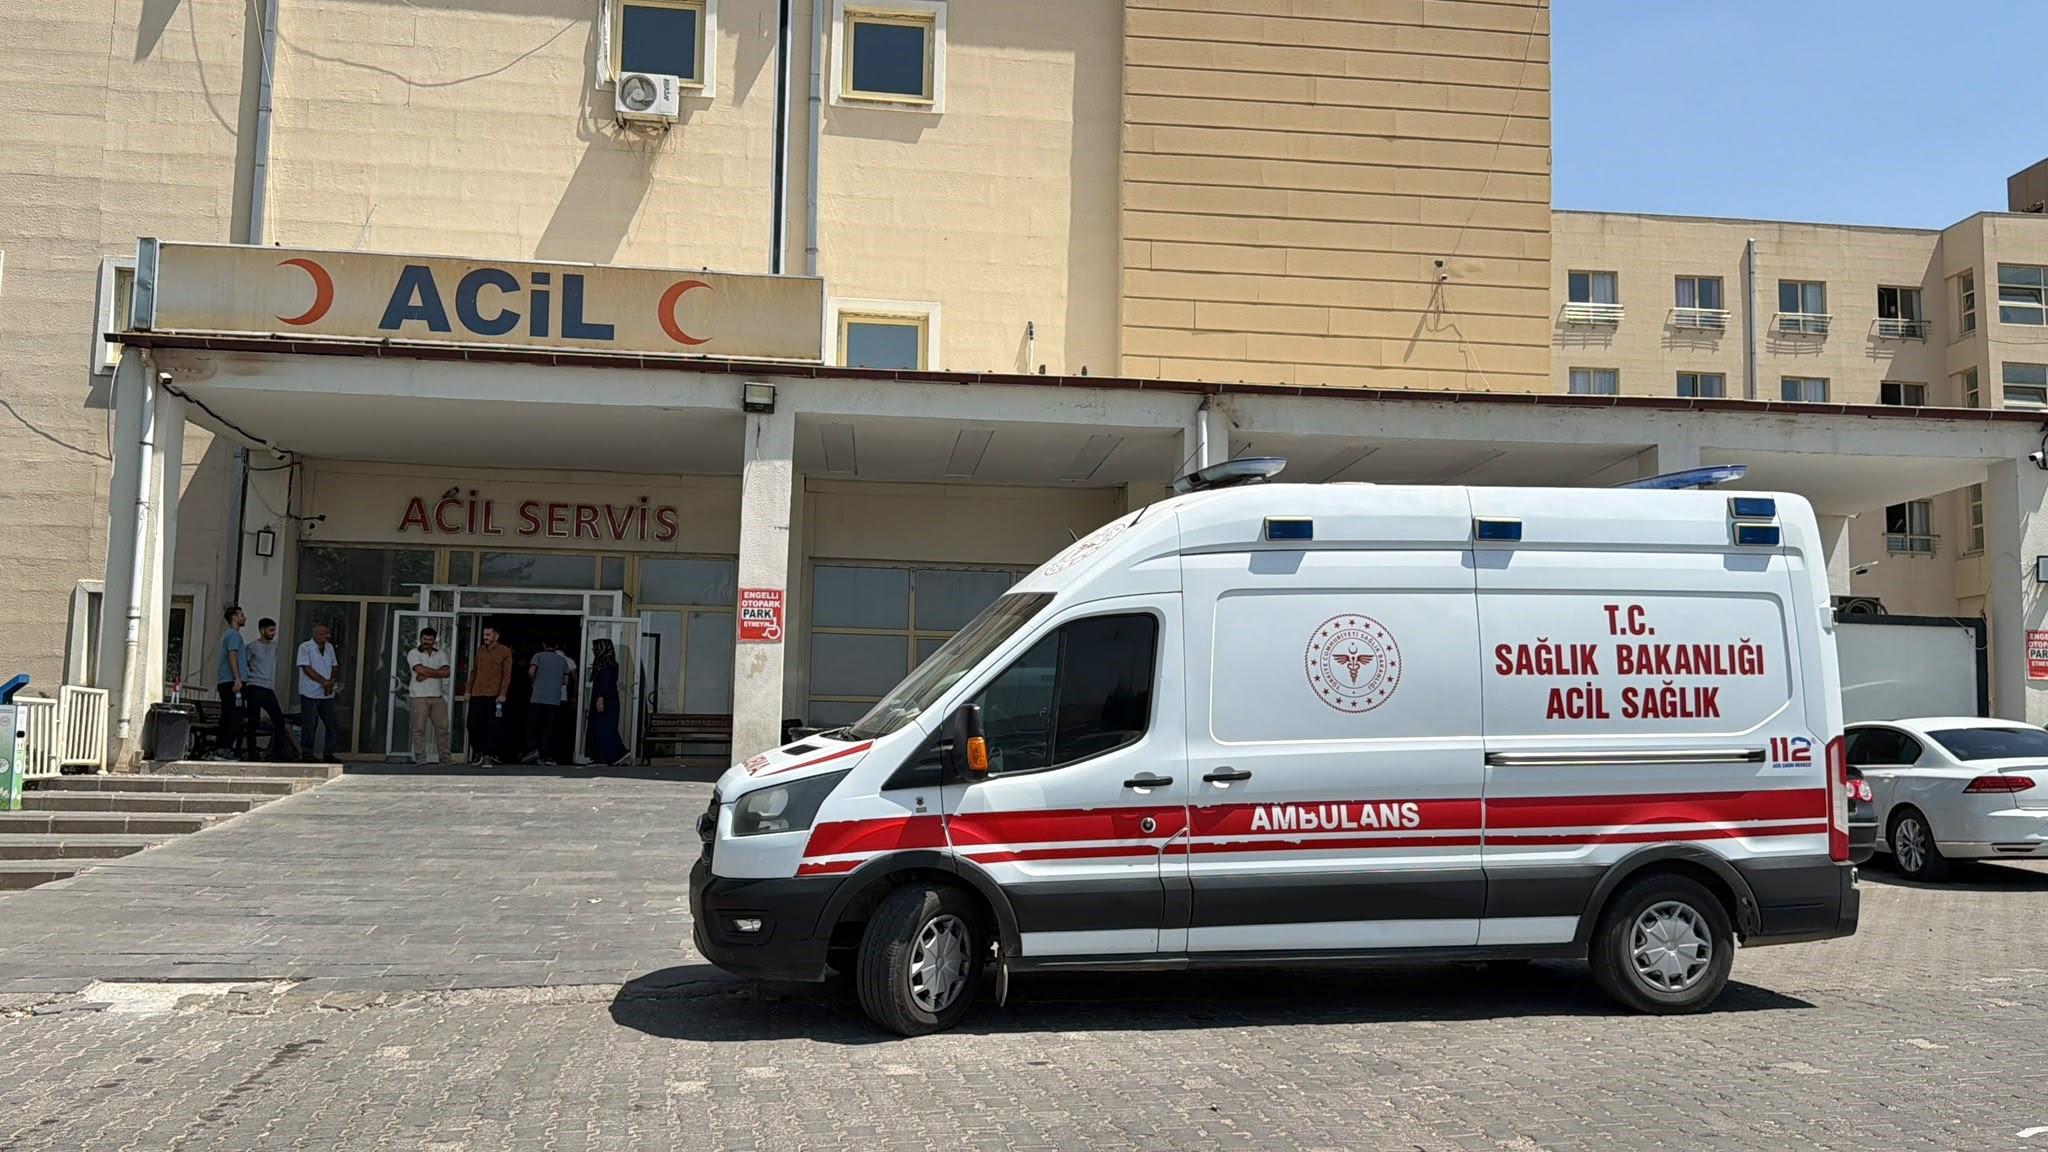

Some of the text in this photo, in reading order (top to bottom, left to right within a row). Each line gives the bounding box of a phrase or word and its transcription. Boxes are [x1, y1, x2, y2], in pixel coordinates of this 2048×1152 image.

[516, 496, 678, 541] SERVİS
[741, 600, 781, 608] OTOPARK
[743, 609, 772, 618] PARK
[1604, 605, 1655, 635] T.C.
[1495, 637, 1765, 675] SAĞLIK BAKANLIĞI
[1546, 679, 1720, 719] ACİL SAĞLIK
[1770, 736, 1812, 762] 112
[1250, 802, 1421, 831] AMBULANS
